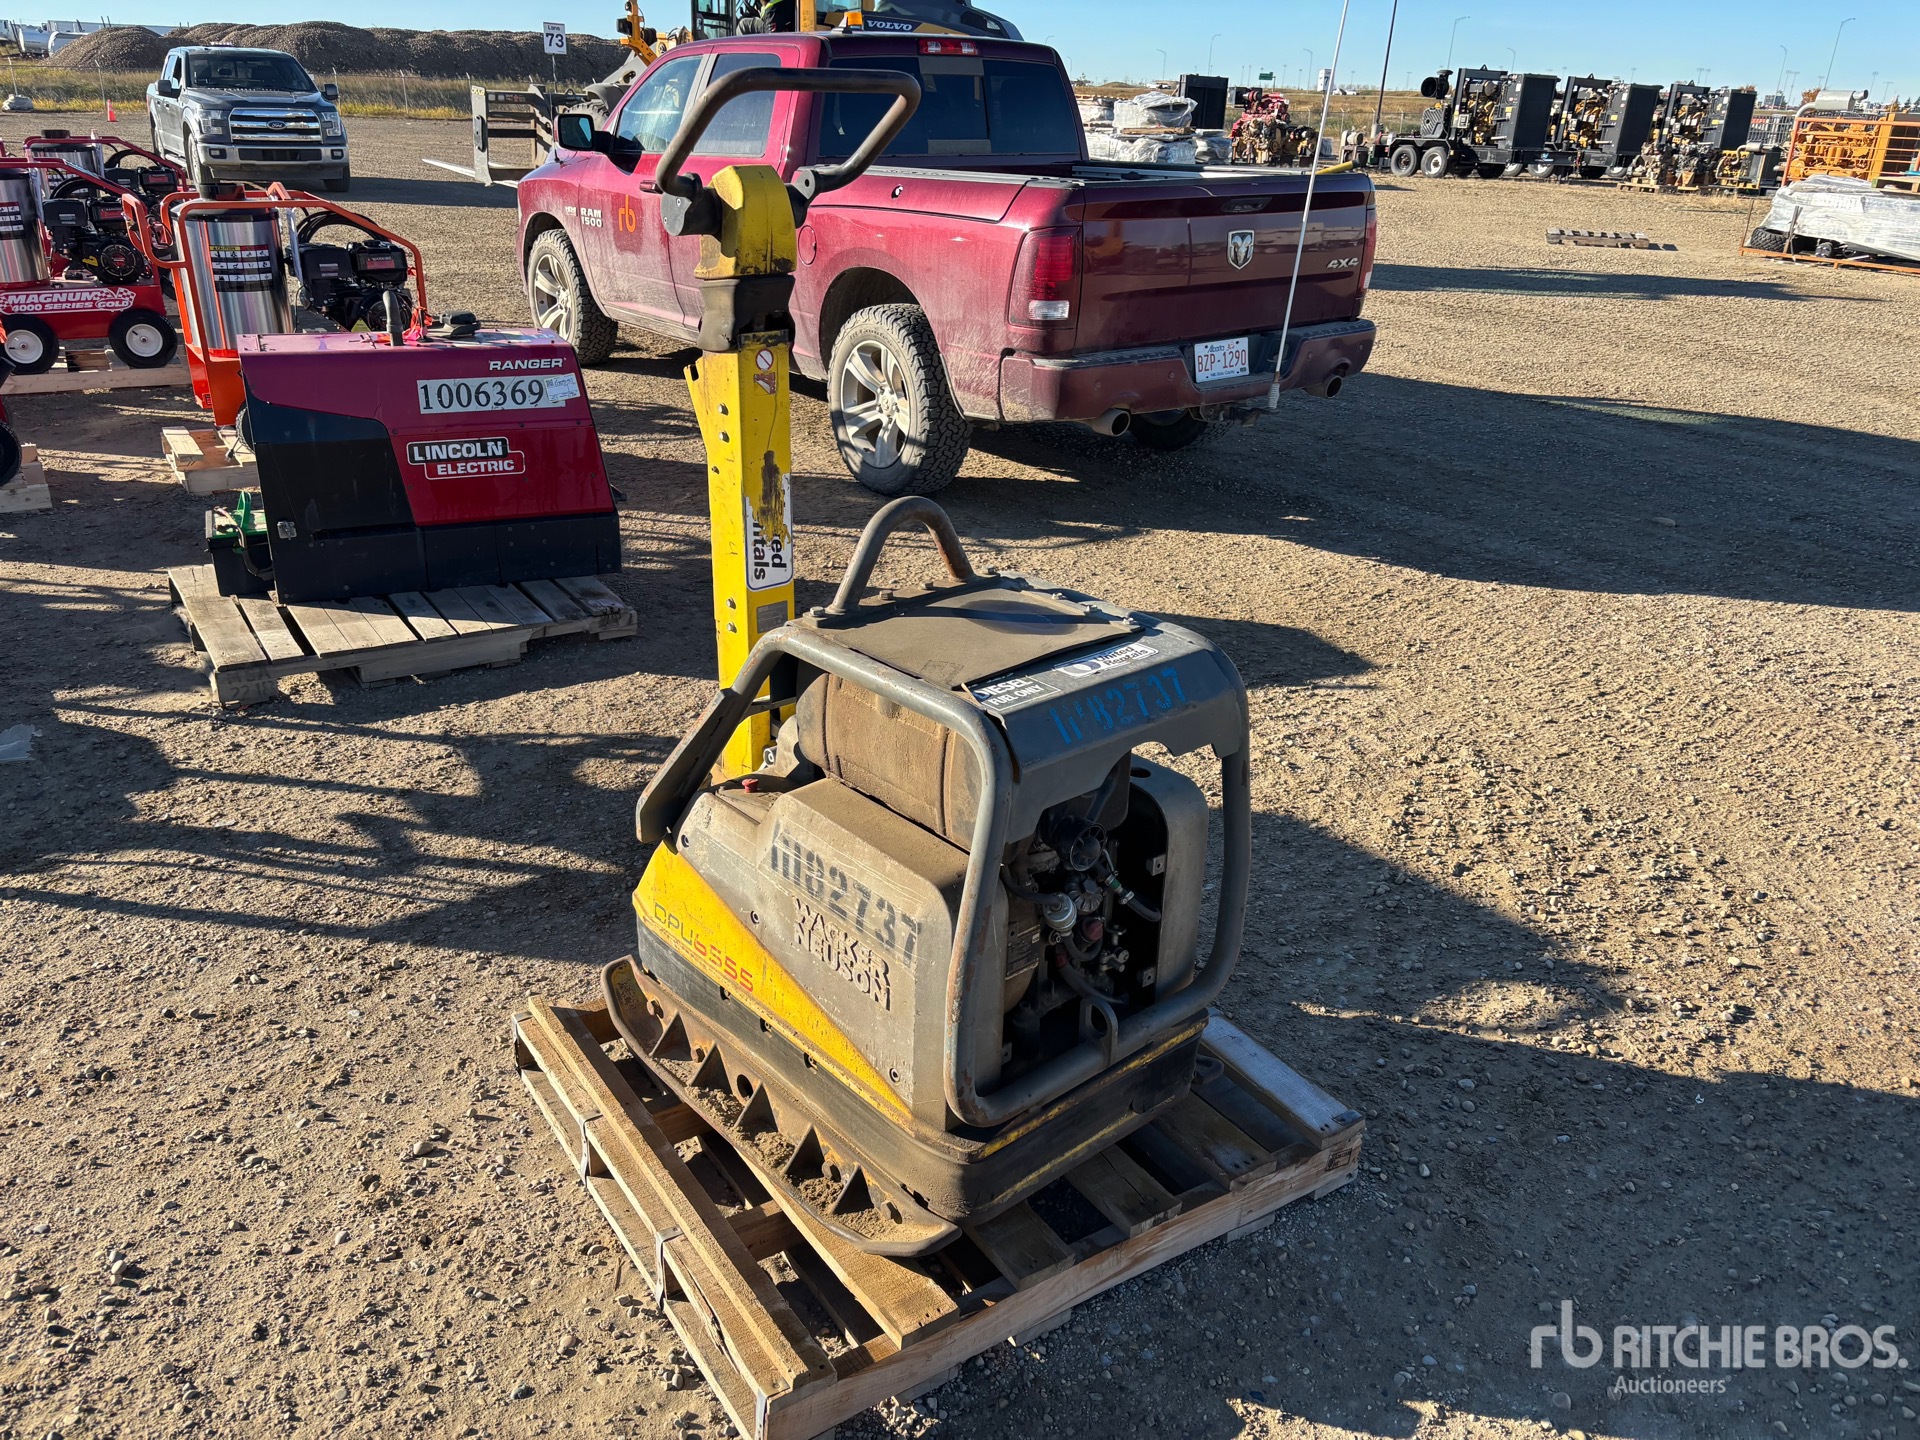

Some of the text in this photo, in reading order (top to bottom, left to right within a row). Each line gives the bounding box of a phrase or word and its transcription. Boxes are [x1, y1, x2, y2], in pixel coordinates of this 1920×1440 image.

[866, 20, 912, 31] VOLVO
[545, 33, 564, 48] 73
[580, 207, 602, 218] RAM
[581, 215, 603, 228] 1500
[7, 291, 100, 304] MAGNUM
[12, 300, 129, 312] 4000 SERIES GOLD
[489, 358, 563, 370] RANGER
[1198, 349, 1246, 372] BZP-1290
[420, 379, 561, 410] 1006369
[413, 441, 503, 461] LINCOLN
[437, 460, 515, 475] ELECTRIC
[1096, 646, 1135, 660] United
[1103, 649, 1149, 666] Rentals
[972, 678, 1033, 700] DIESEL
[988, 684, 1044, 705] FUEL ONLY
[654, 902, 753, 992] DPU6555
[792, 897, 890, 987] WACKER
[794, 923, 890, 1011] NEUSON
